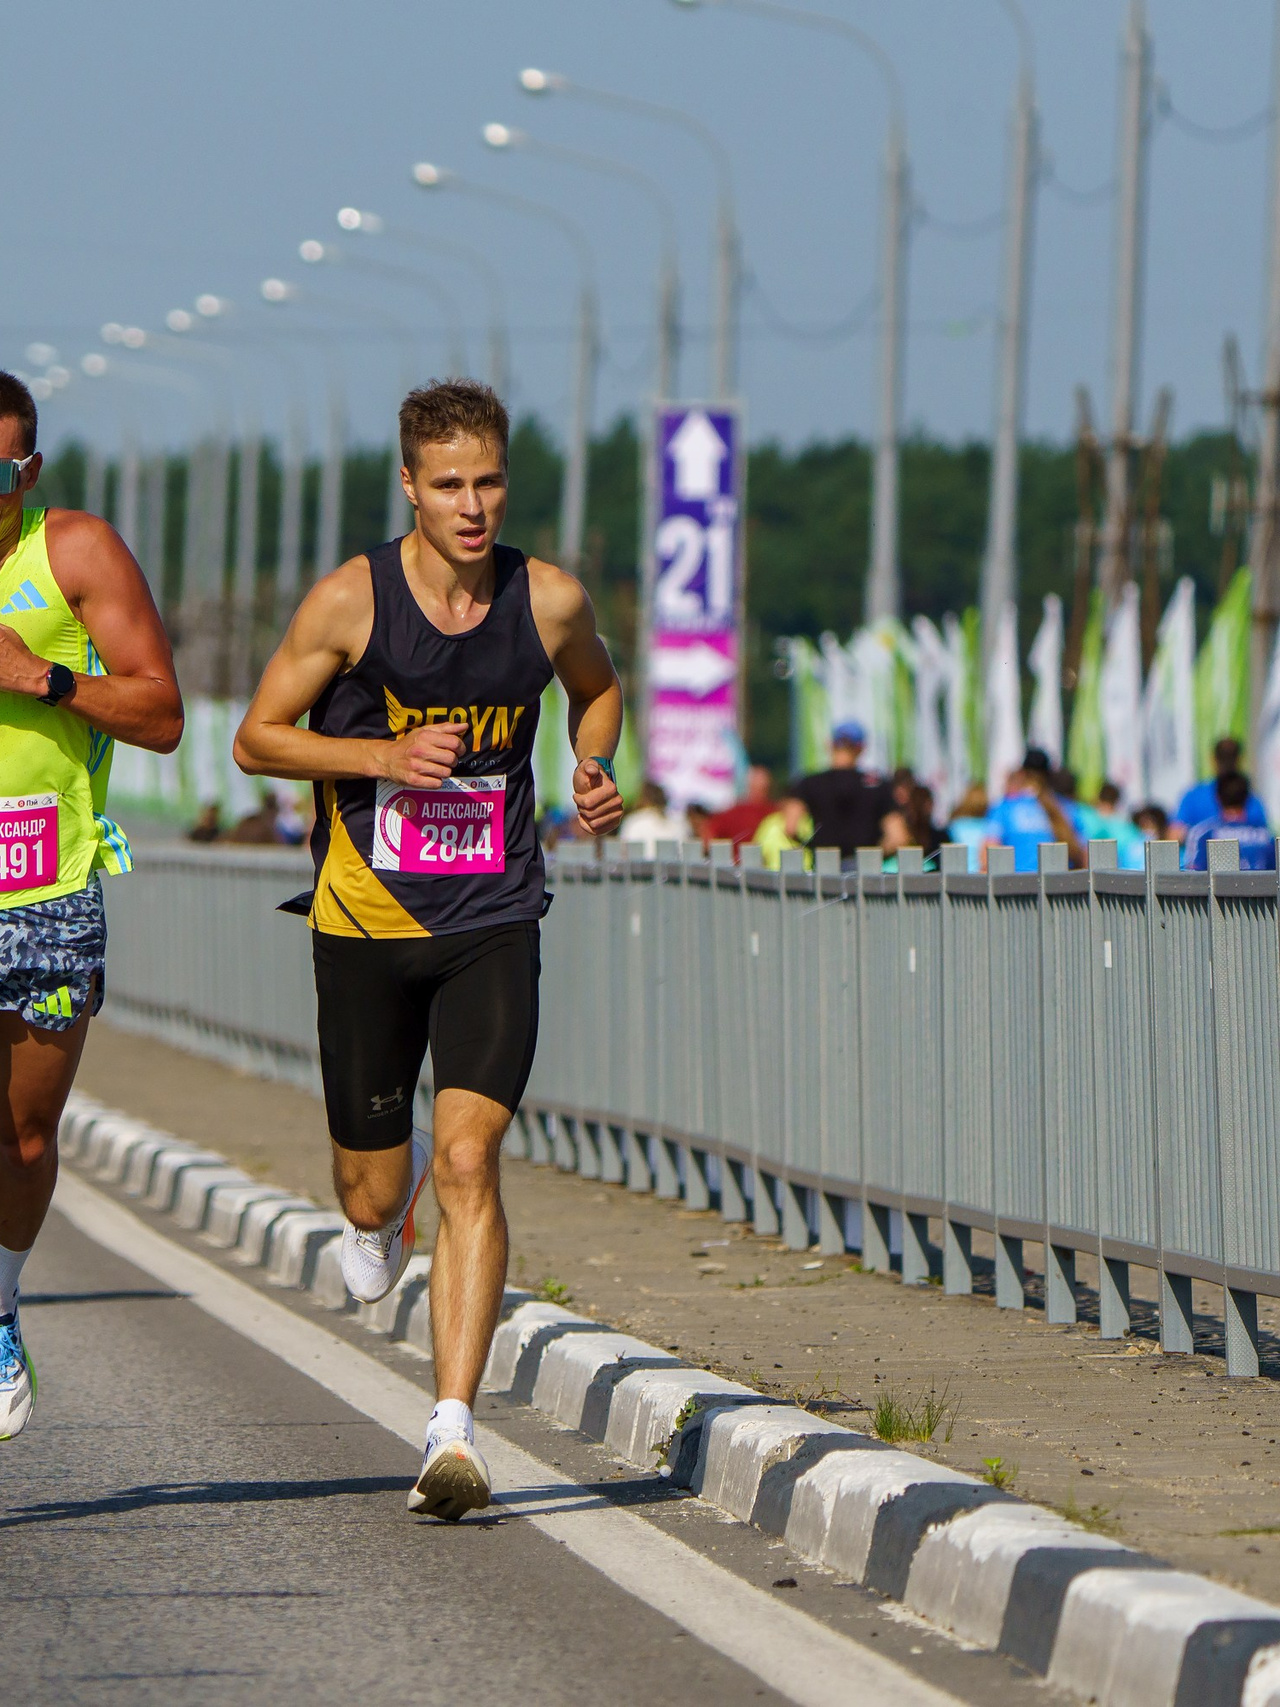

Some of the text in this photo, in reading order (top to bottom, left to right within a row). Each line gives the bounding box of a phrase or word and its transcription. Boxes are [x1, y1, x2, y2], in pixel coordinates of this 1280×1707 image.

[656, 514, 734, 615] 21
[26, 799, 39, 807] Пэй
[421, 801, 494, 820] АЛЕКСАНДР
[419, 824, 493, 862] 2844
